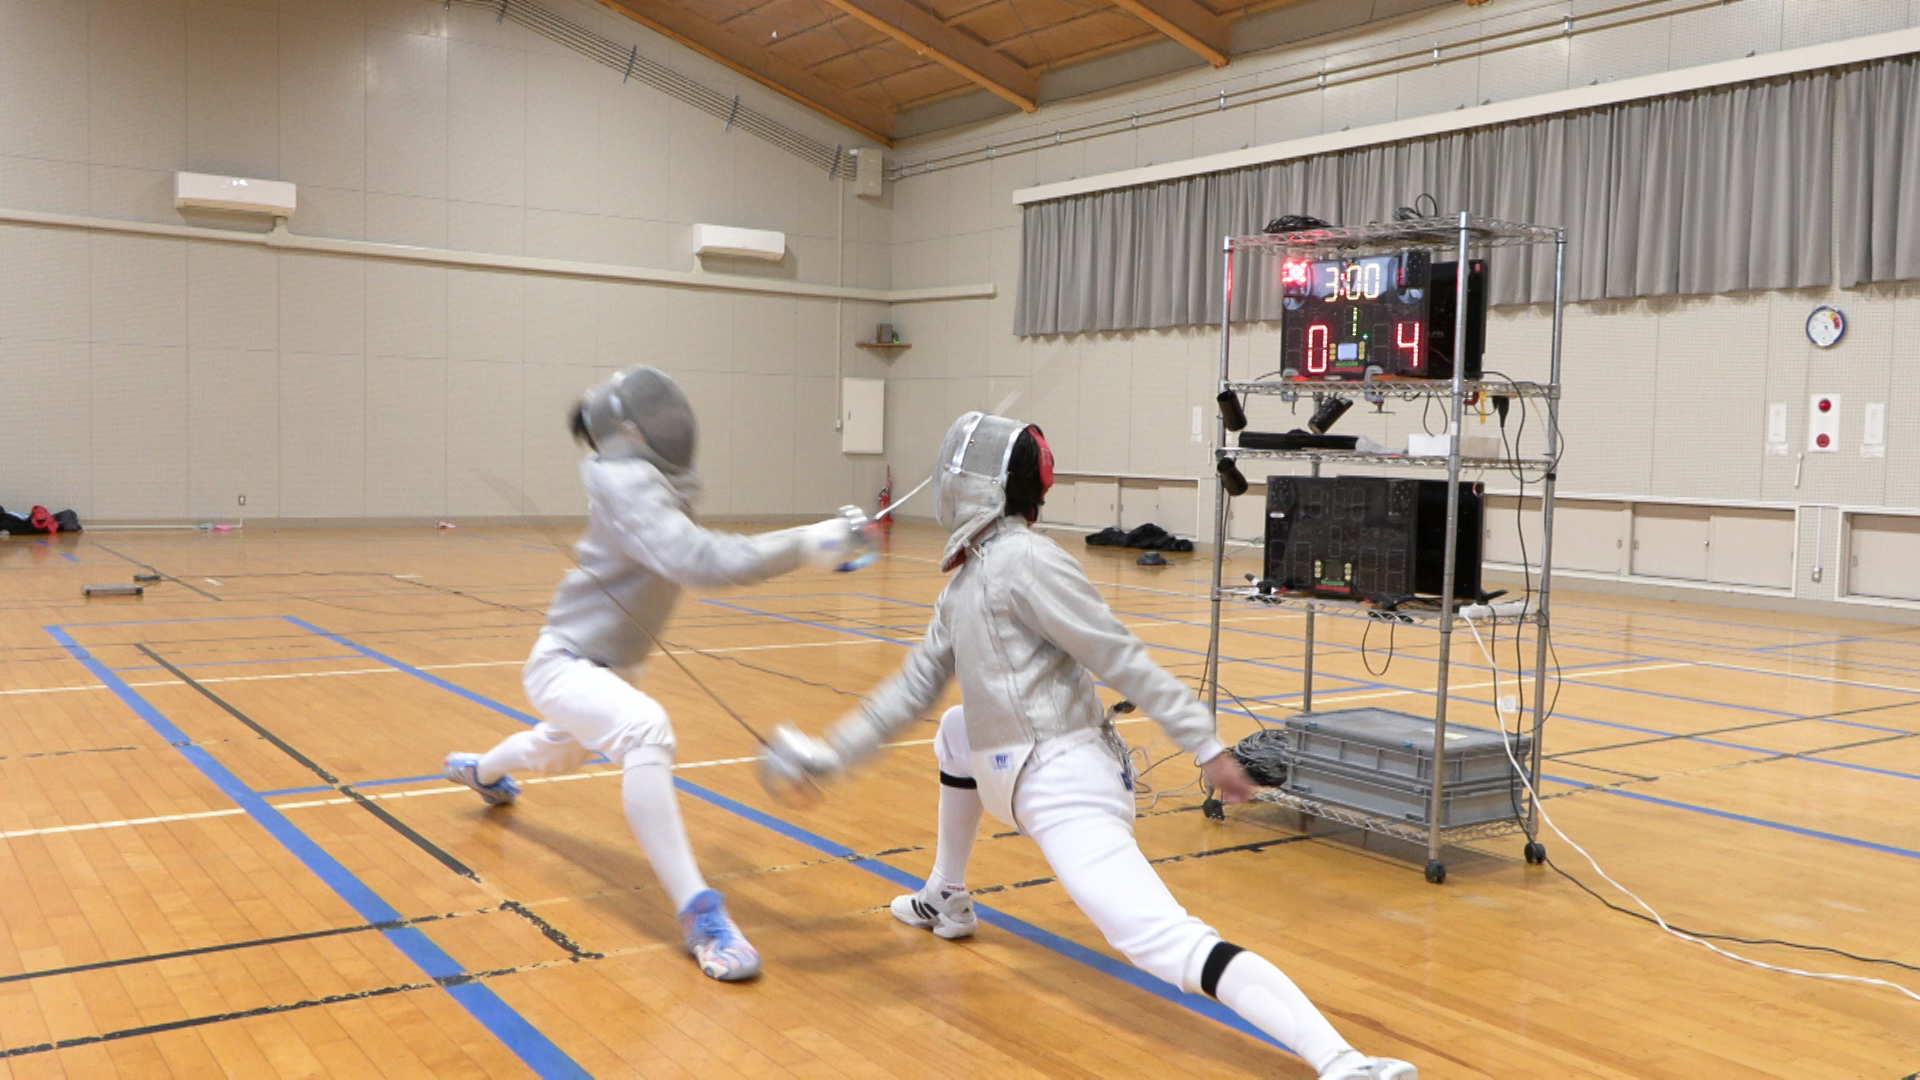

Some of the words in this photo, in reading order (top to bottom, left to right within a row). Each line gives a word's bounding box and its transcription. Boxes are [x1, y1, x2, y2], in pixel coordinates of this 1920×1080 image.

[1324, 262, 1380, 302] 3:00
[1307, 324, 1328, 373] 0
[1397, 321, 1420, 368] 4
